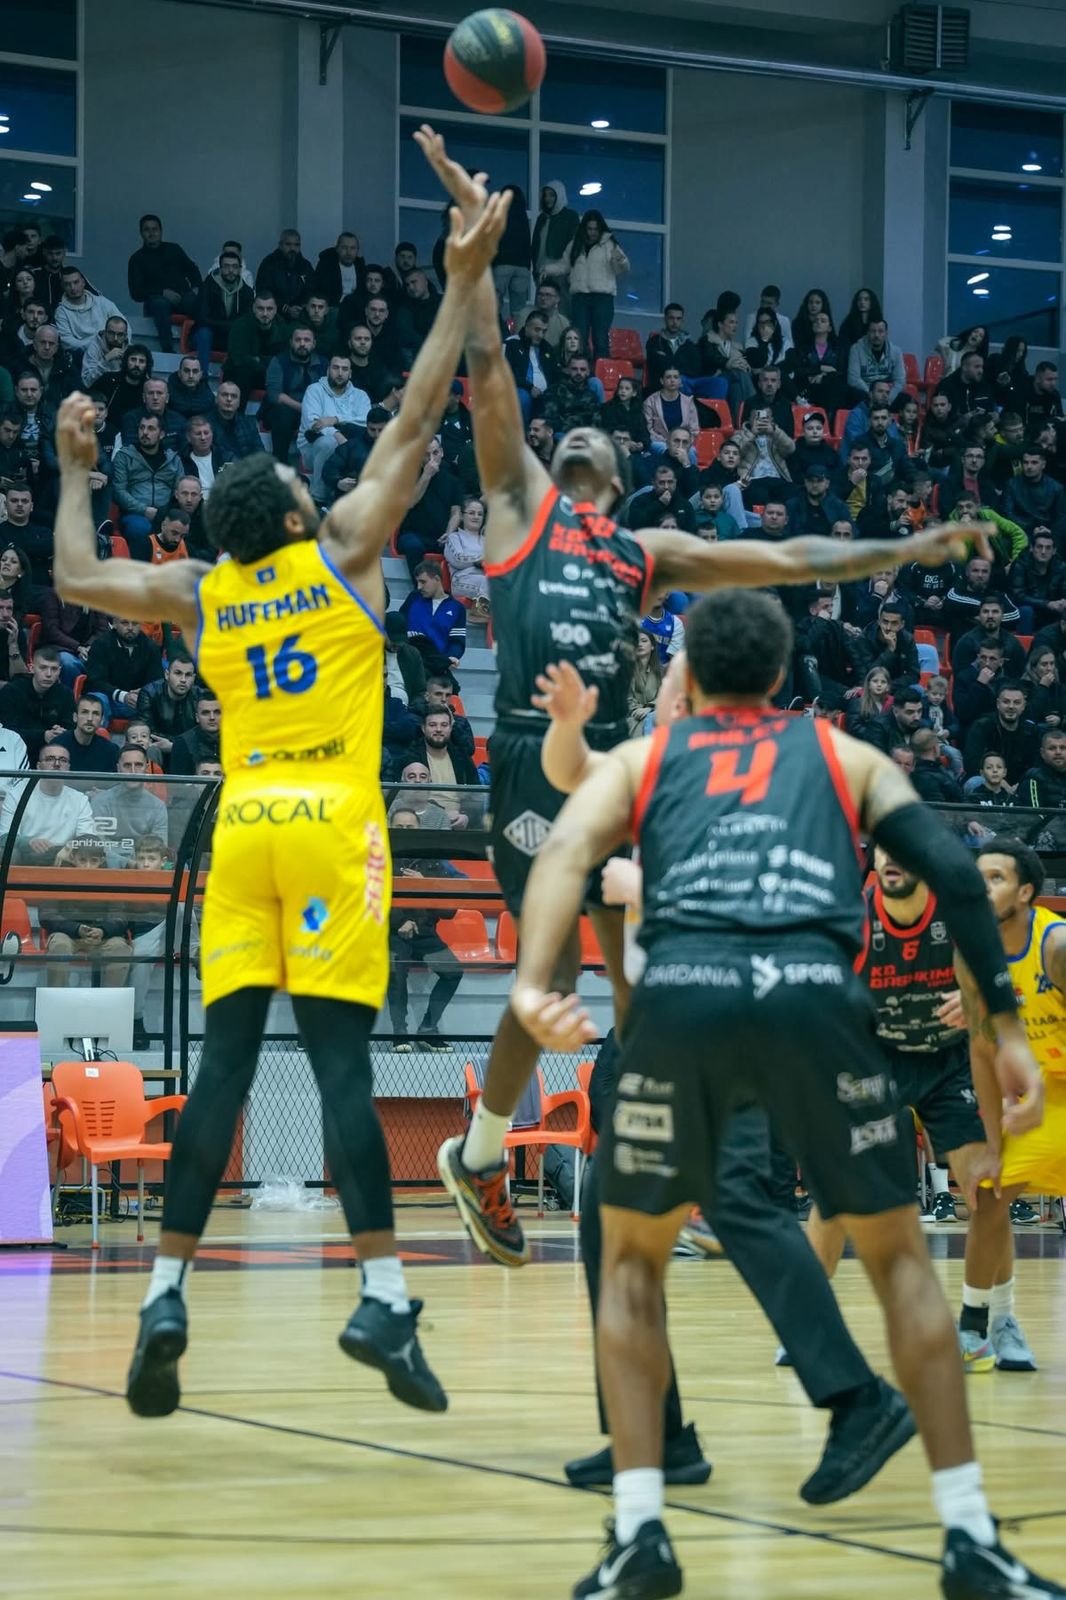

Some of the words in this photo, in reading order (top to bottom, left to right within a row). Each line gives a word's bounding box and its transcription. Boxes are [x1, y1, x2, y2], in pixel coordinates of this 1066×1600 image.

[217, 584, 332, 631] HUFFMAN
[246, 633, 318, 699] 16
[705, 739, 778, 805] 4
[224, 797, 333, 826] ROCAL
[902, 940, 920, 960] 6
